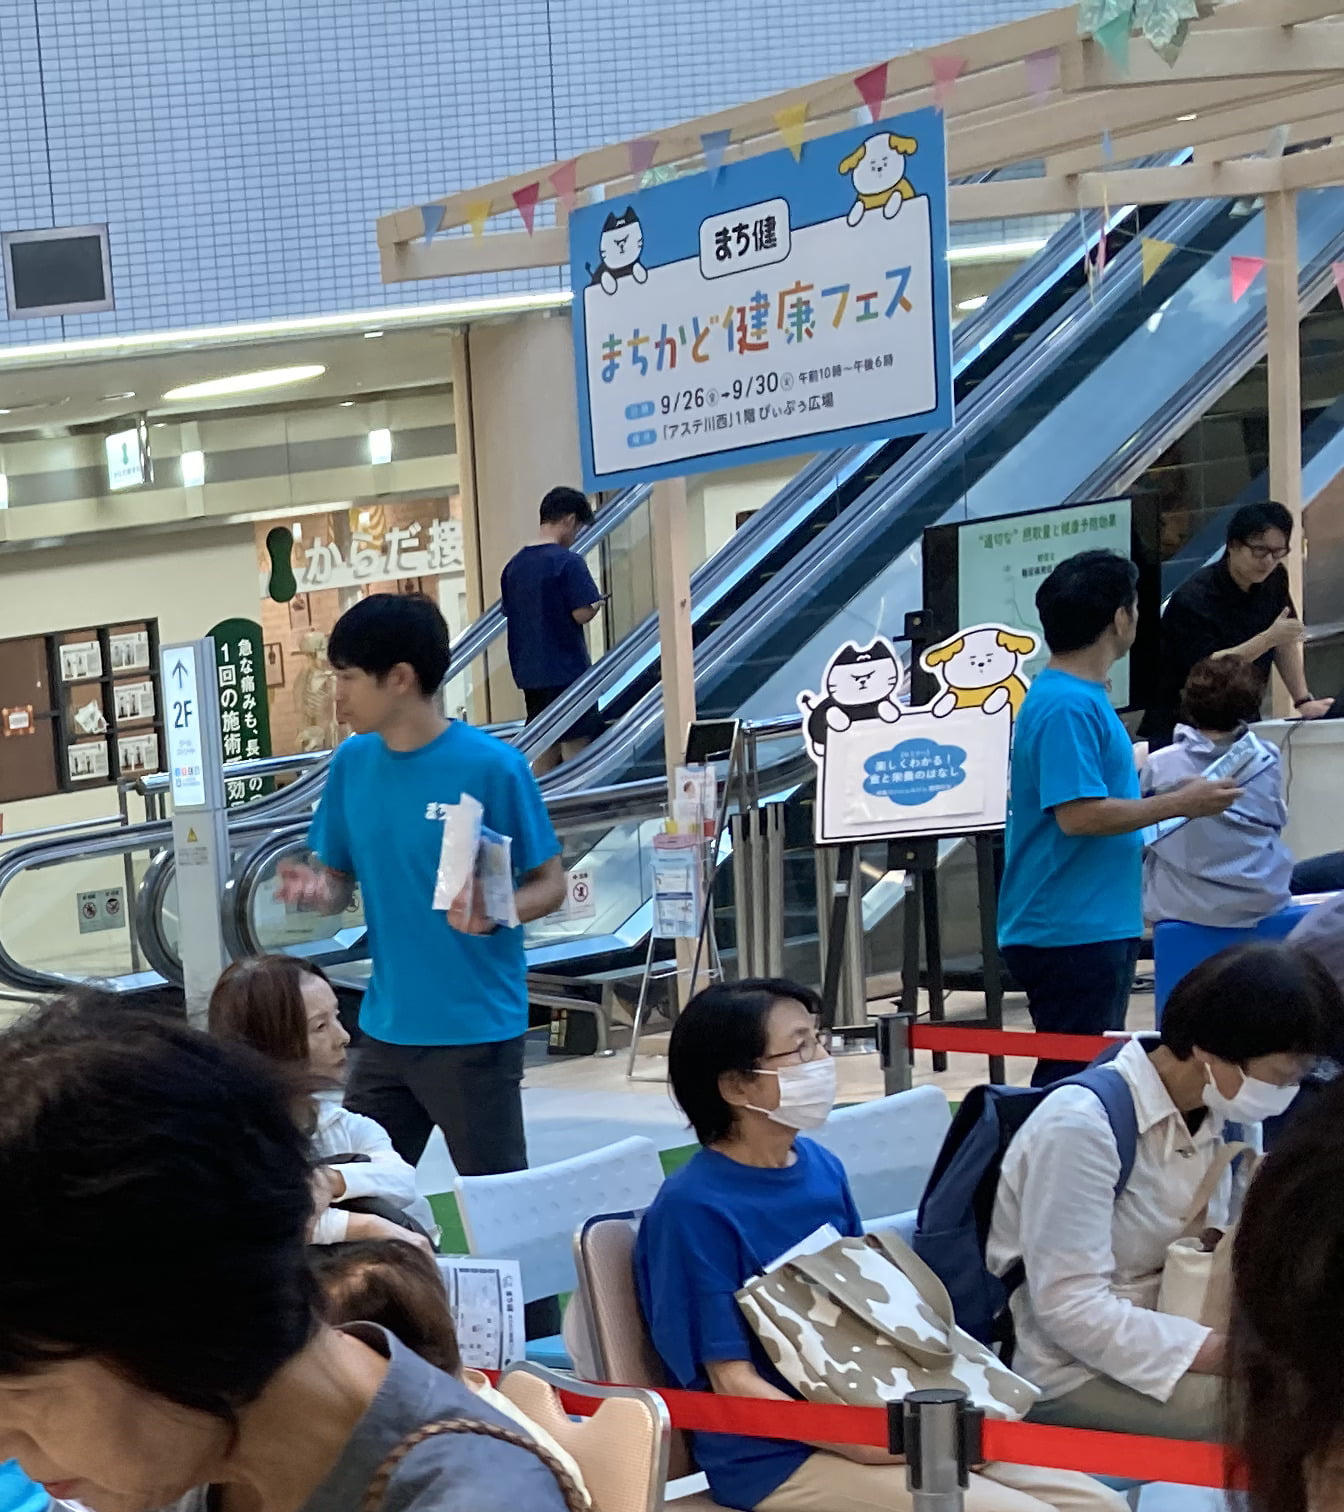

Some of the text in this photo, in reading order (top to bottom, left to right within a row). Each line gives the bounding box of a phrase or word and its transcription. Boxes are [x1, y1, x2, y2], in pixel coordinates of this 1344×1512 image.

[714, 215, 778, 261] まち健
[600, 265, 914, 384] まちかど健康フェス
[173, 700, 193, 729] 2F
